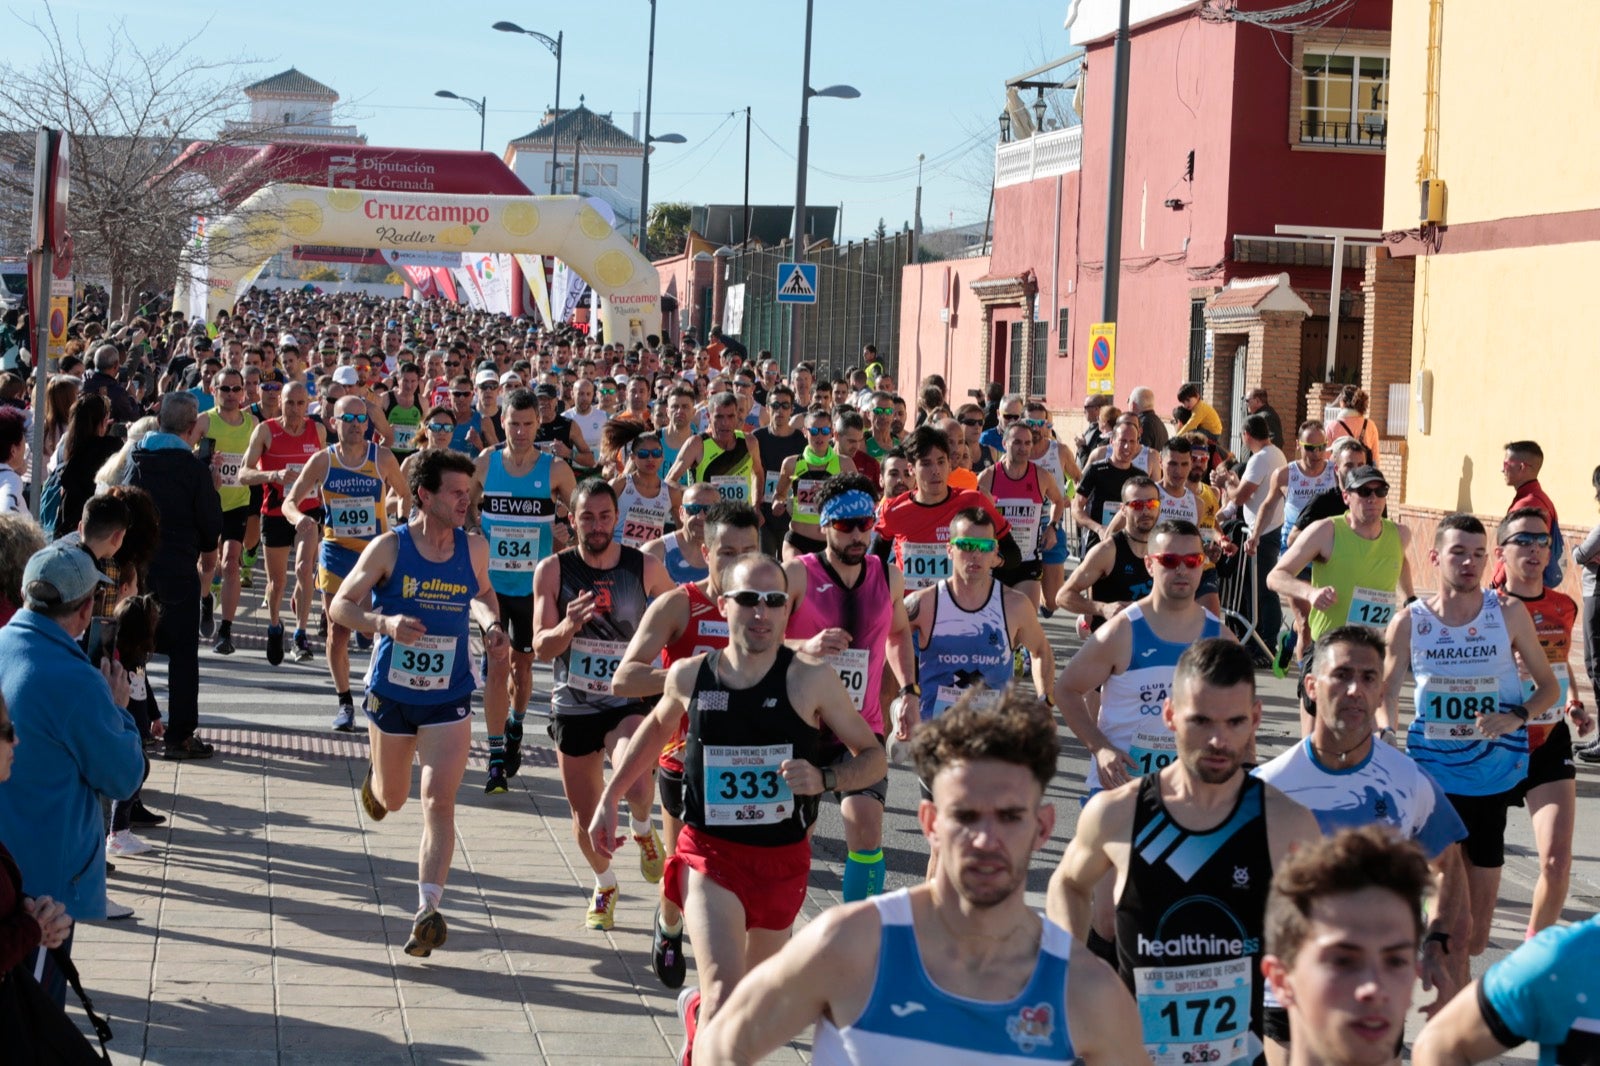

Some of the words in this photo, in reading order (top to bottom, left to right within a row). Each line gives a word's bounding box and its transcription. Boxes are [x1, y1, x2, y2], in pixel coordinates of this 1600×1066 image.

[362, 158, 435, 174] Diputación
[362, 175, 377, 187] de
[379, 176, 434, 190] Granada
[364, 198, 490, 225] Cruzcampo
[376, 226, 436, 245] Radler
[609, 293, 657, 304] Cruzcampo
[329, 476, 377, 490] agustinos
[339, 509, 369, 525] 499
[625, 523, 662, 540] 2279
[497, 540, 531, 557] 634
[904, 557, 949, 575] 1011
[419, 591, 450, 600] deportes
[421, 578, 468, 596] olimpo
[938, 654, 969, 664] TODO
[971, 654, 1000, 665] SUMA
[1425, 644, 1498, 660] MARACENA
[401, 650, 445, 673] 393
[581, 656, 621, 678] 139
[1140, 682, 1165, 691] CLUB
[1430, 695, 1496, 720] 1088
[740, 748, 760, 756] PREMIO
[761, 748, 768, 756] DE
[769, 747, 787, 756] FONDO
[719, 770, 779, 799] 333
[1137, 933, 1260, 957] healthiness
[1164, 970, 1184, 980] GRAN
[1185, 967, 1212, 979] PREMIO
[1214, 966, 1222, 977] DE
[1224, 962, 1246, 975] FONDO
[1174, 979, 1218, 992] DIPUTACIÓN
[1160, 995, 1237, 1037] 172
